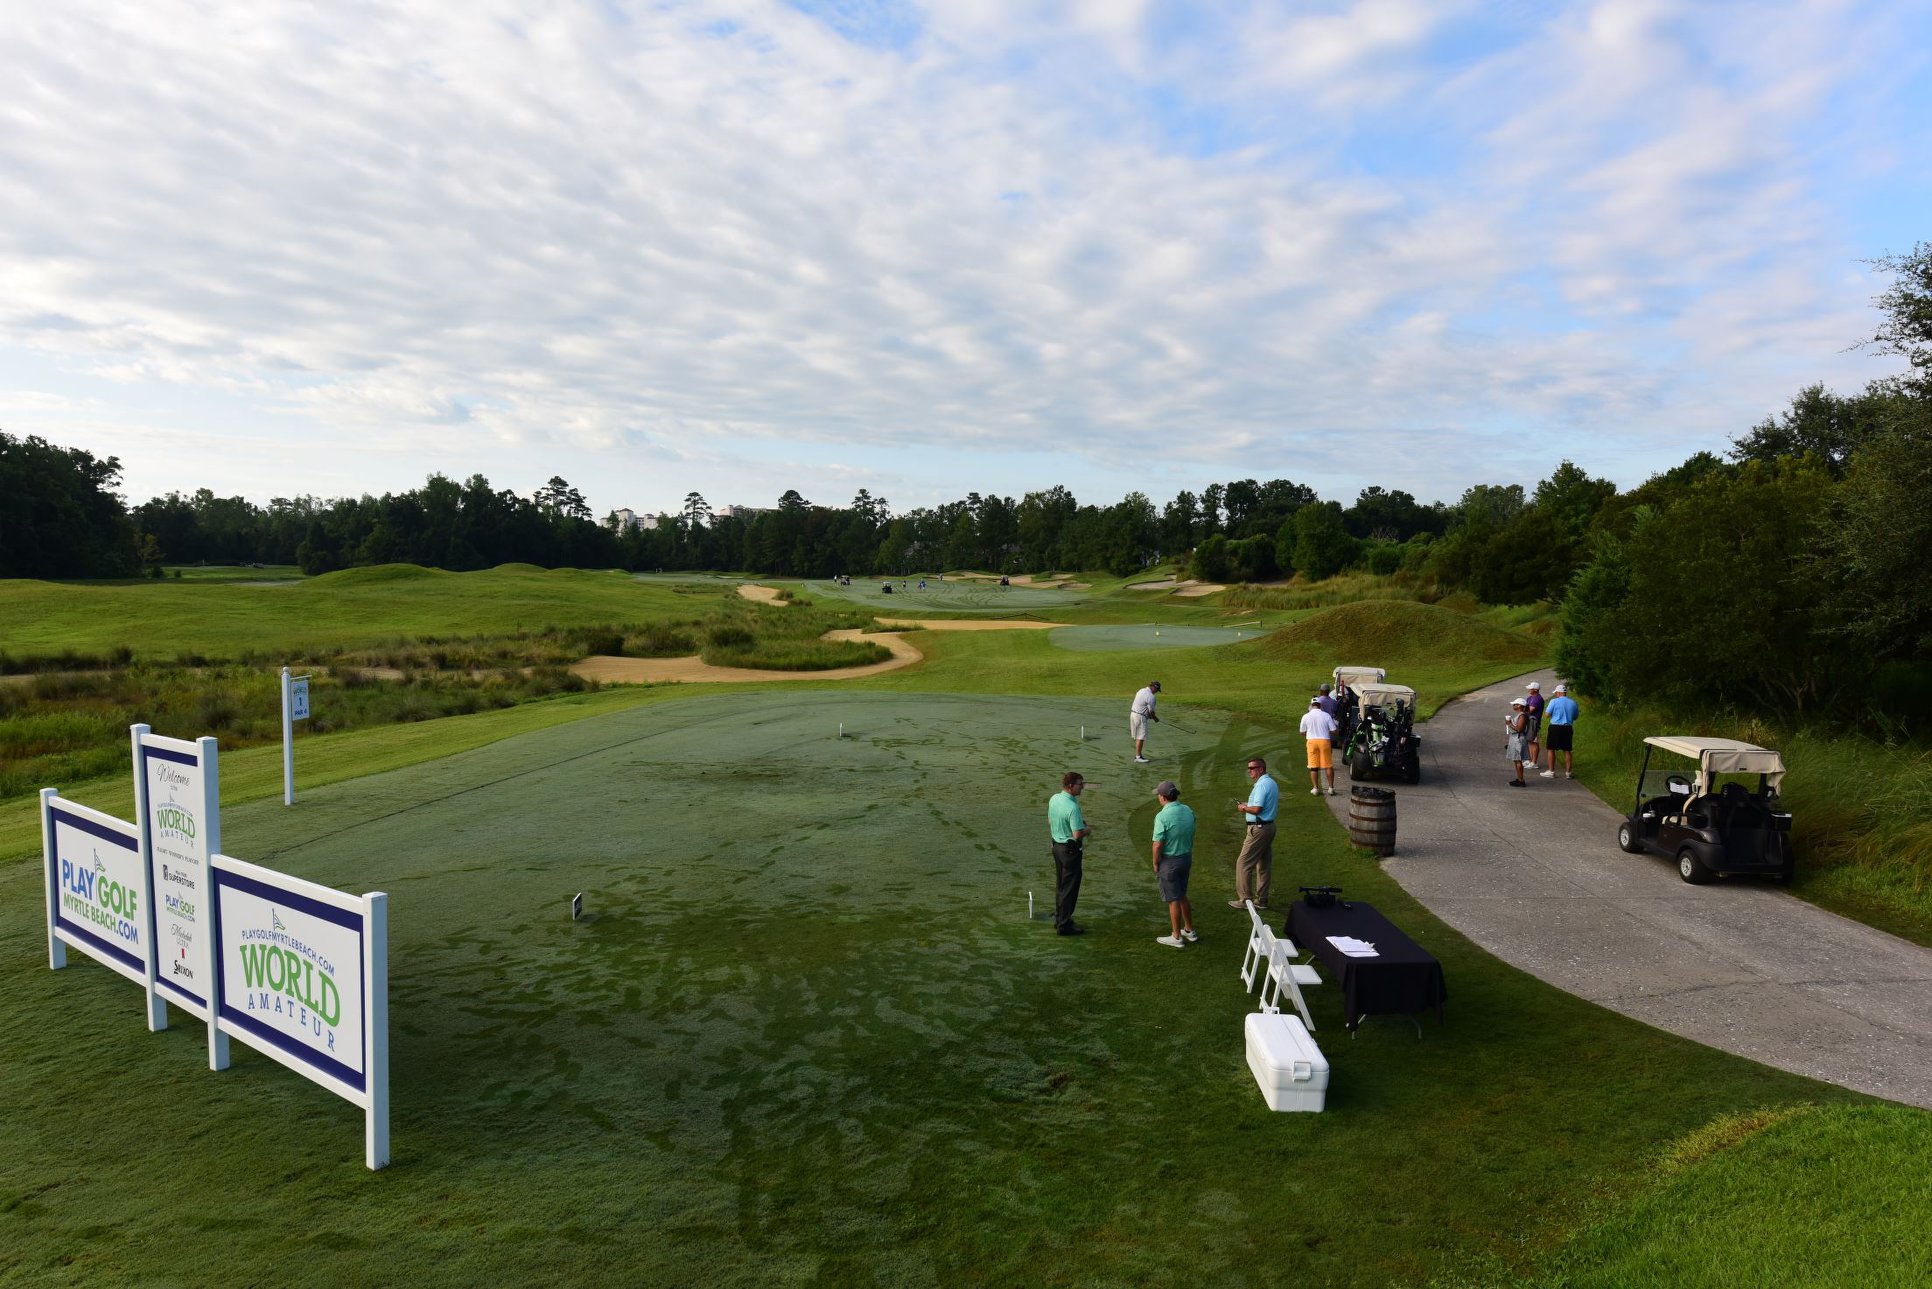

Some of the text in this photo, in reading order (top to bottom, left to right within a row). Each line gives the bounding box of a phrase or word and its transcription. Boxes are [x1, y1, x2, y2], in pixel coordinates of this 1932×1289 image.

[299, 697, 302, 706] 1
[157, 763, 190, 786] Welcome
[157, 808, 195, 838] WORLD
[160, 830, 194, 848] AMATEUR
[62, 858, 137, 921] PLAY GOLF
[168, 872, 195, 890] SUPERSTORE
[63, 892, 139, 944] MYRTLE BEACH.COM
[165, 894, 195, 915] PLAY GOLF
[241, 928, 335, 976] PLAYGOLFMYRTLEBEACH.COM
[239, 943, 341, 1028] WORLD
[247, 992, 335, 1052] AMATEUR
